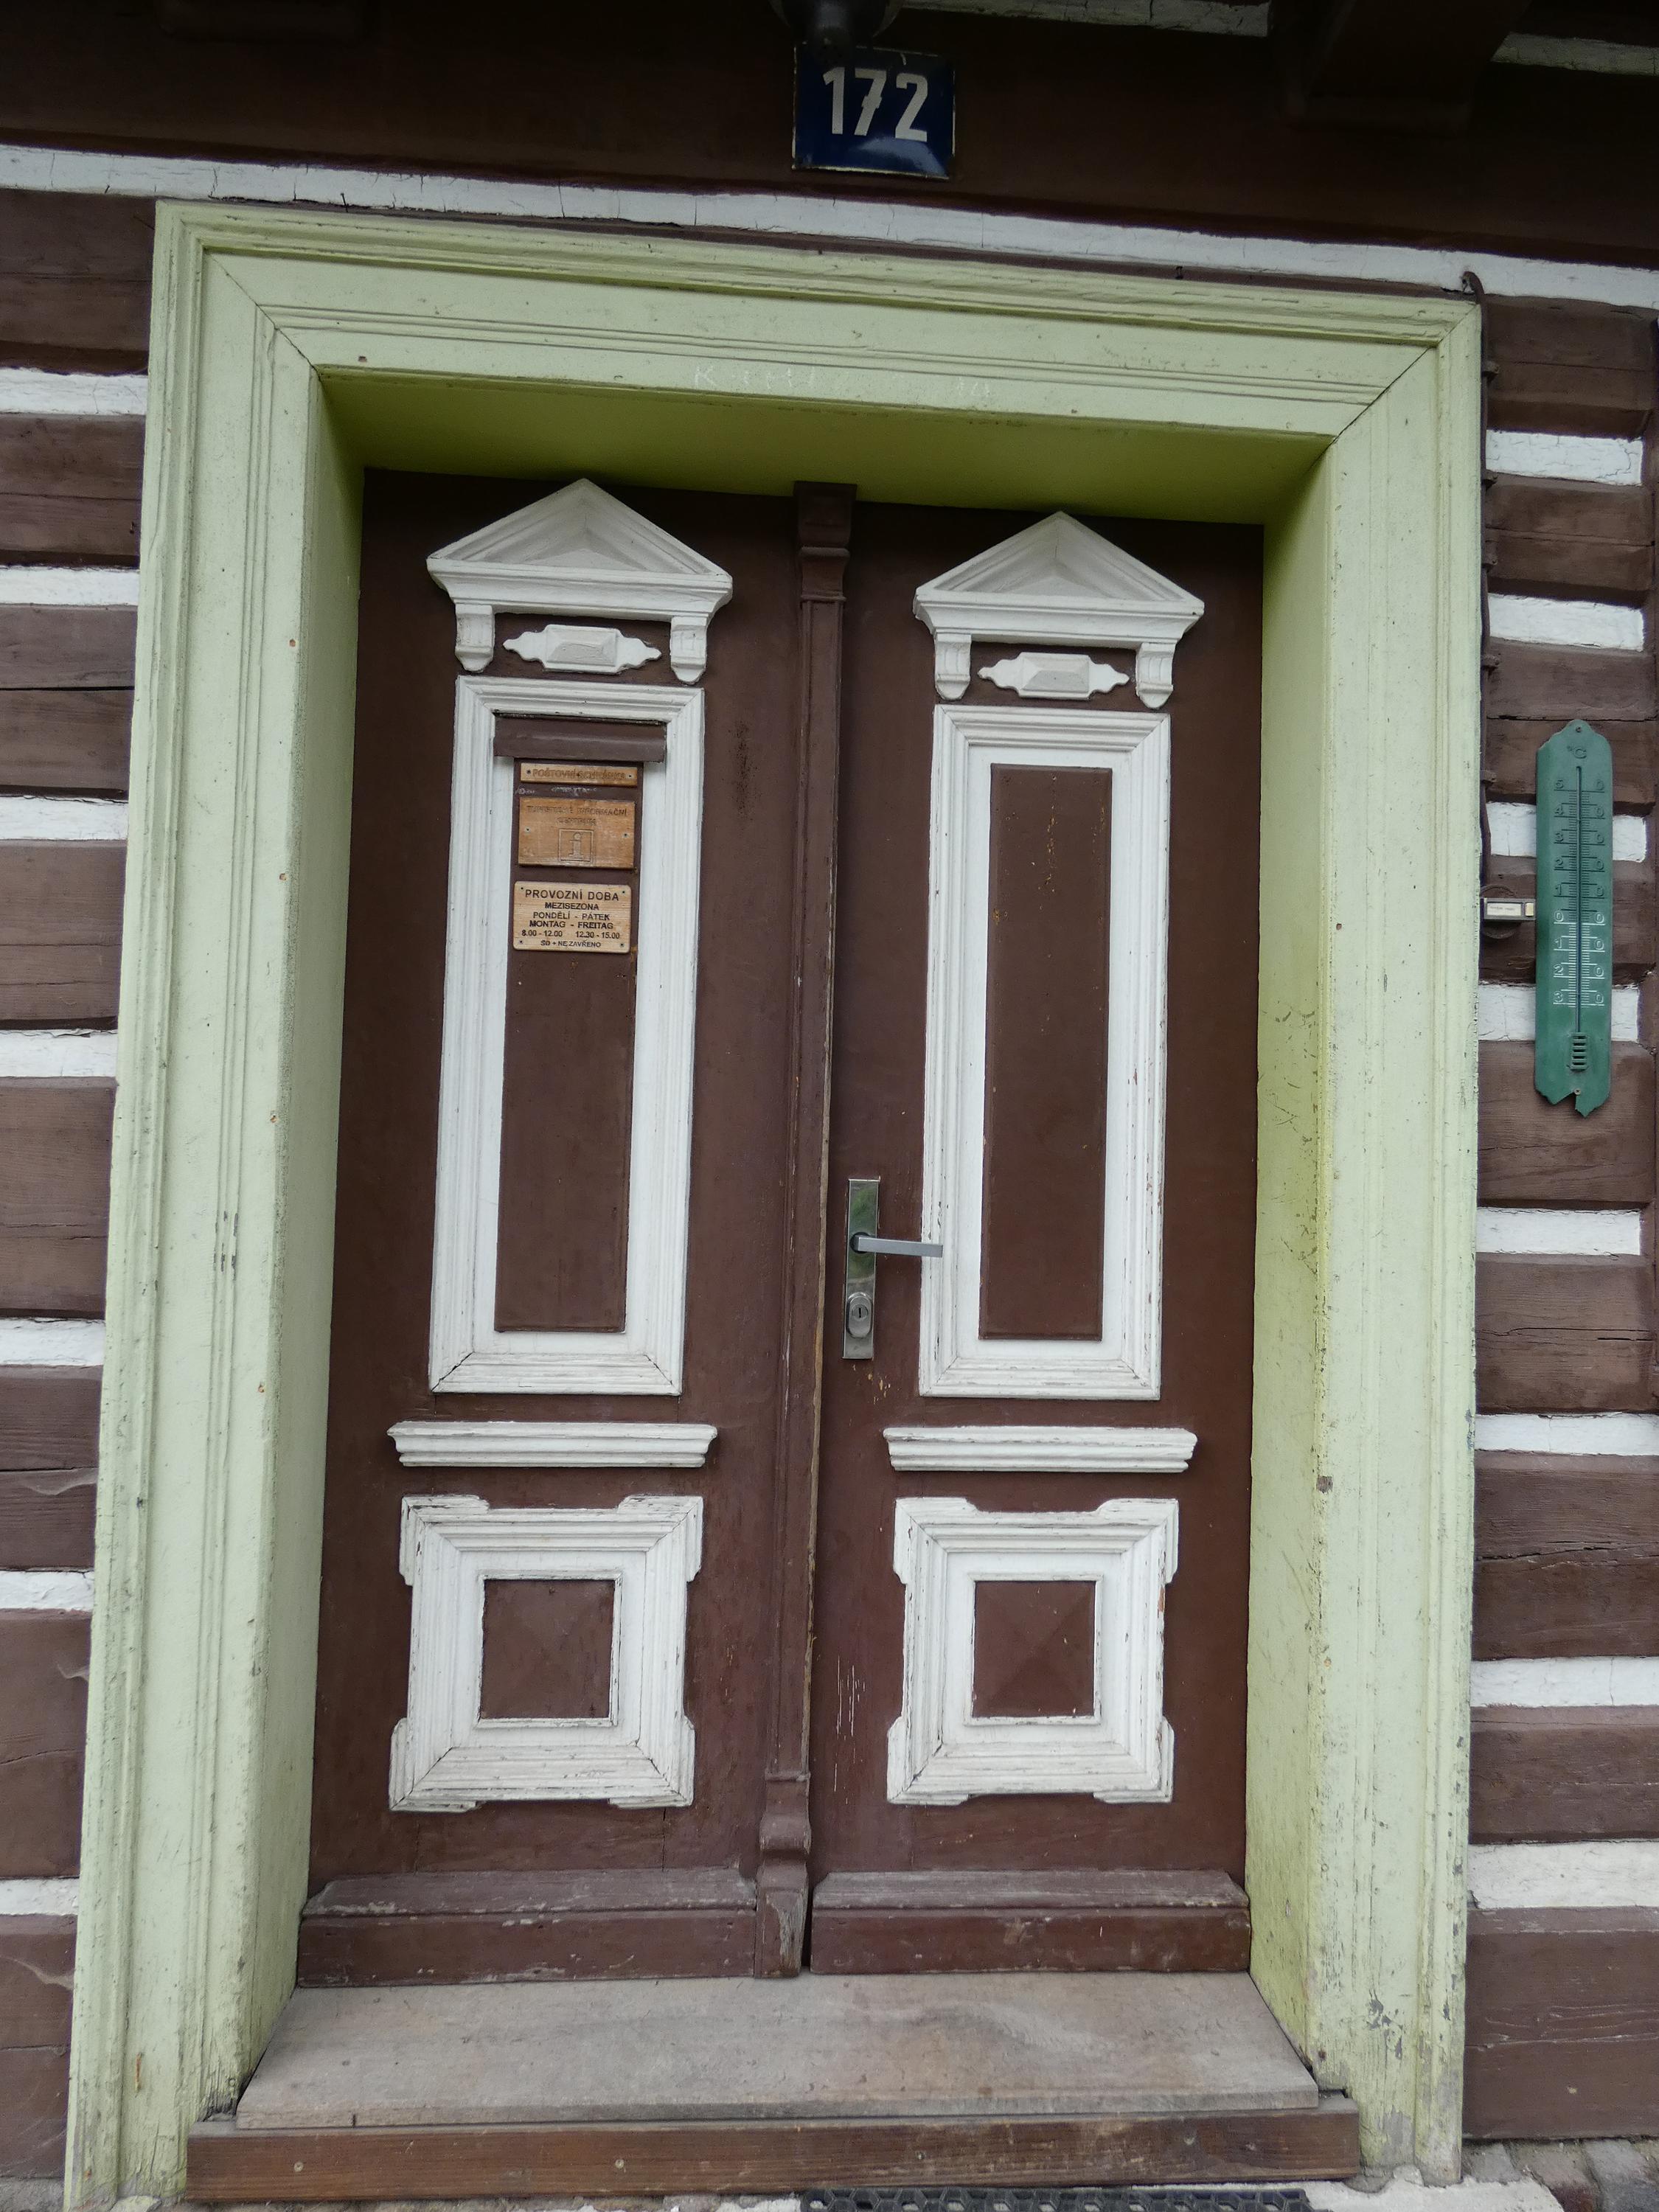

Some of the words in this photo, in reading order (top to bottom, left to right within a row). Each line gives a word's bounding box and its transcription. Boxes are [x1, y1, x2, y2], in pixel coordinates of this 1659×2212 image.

[822, 66, 928, 142] 172
[525, 888, 582, 900] PROVOZNÍ
[588, 891, 619, 901] DOBA
[544, 902, 599, 911] MEZISEZONA
[532, 911, 571, 920] PONDĚLÍ
[582, 913, 611, 921] PÁTEK
